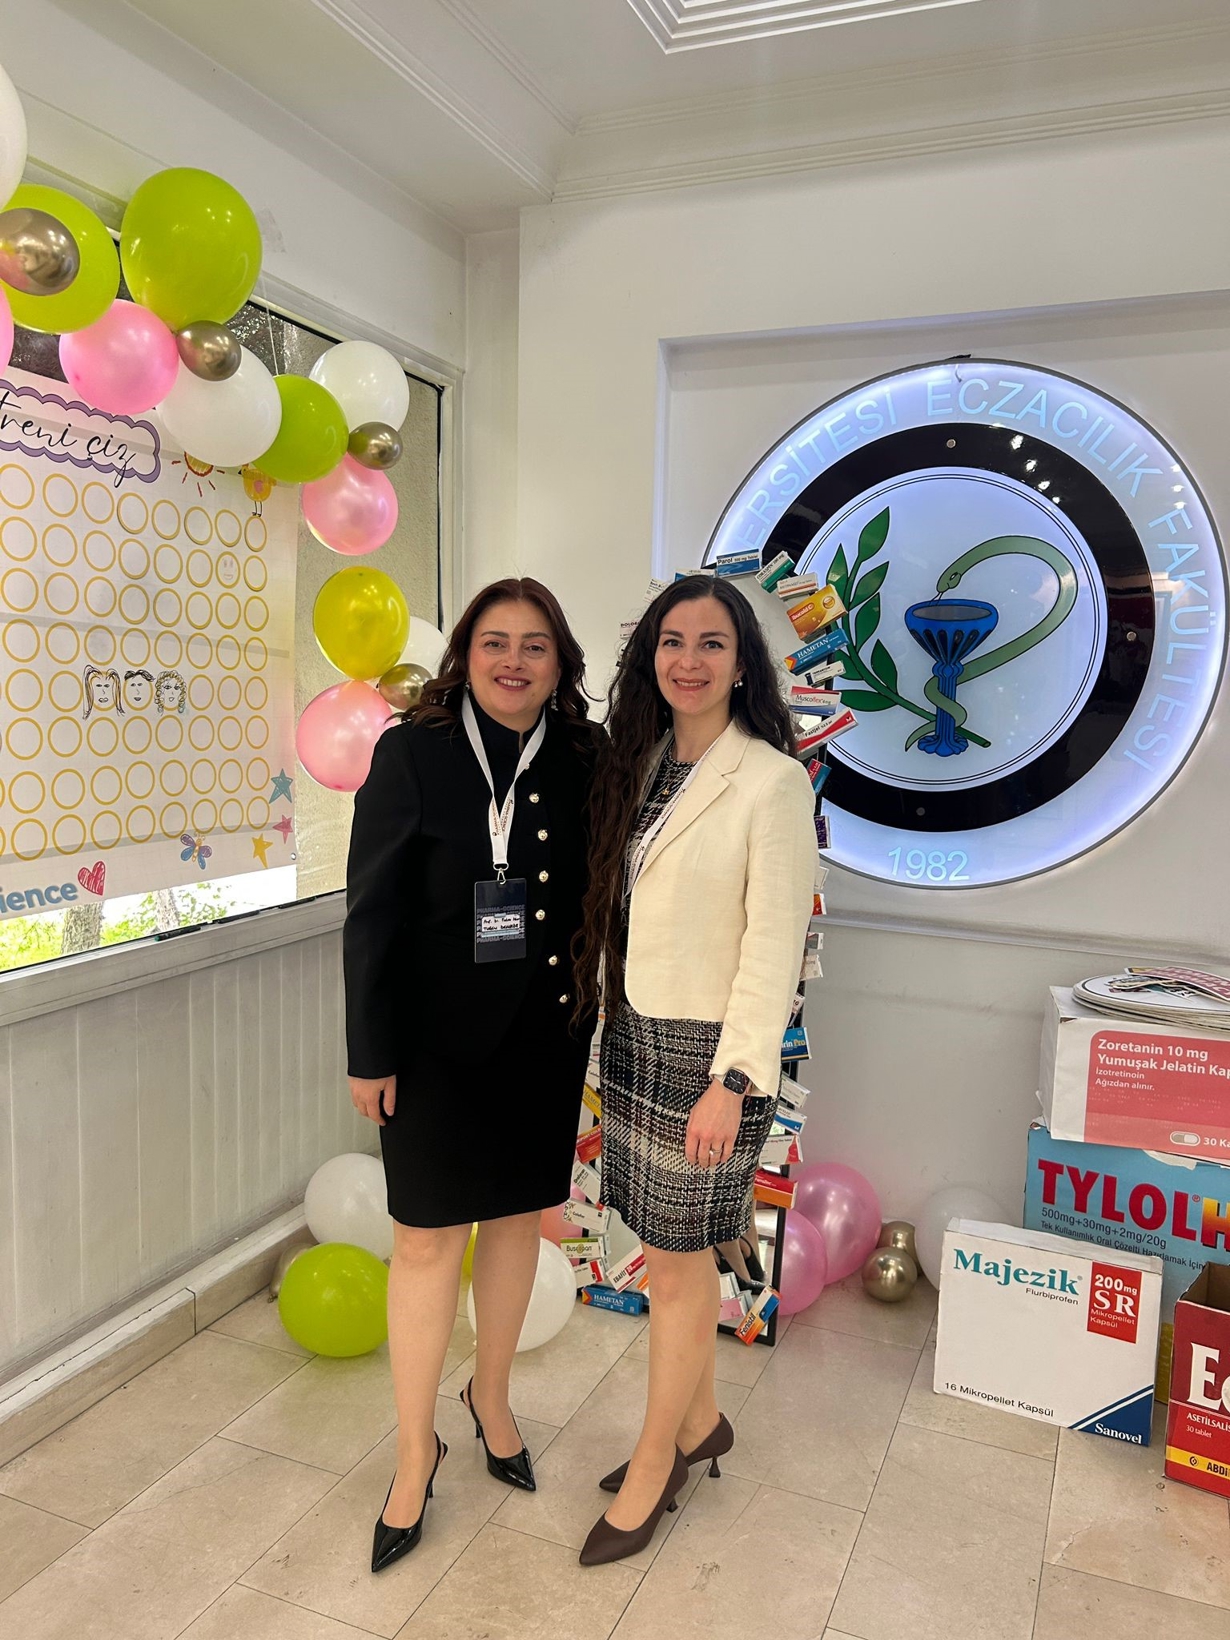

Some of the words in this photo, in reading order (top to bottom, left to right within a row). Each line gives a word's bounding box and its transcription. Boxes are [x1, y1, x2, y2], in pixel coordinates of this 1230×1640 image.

[926, 378, 1164, 498] ECZACILIK
[86, 434, 137, 488] çiz
[717, 557, 733, 565] Parol
[797, 639, 829, 658] HAMETAN
[888, 846, 970, 881] 1982
[0, 882, 78, 914] ience
[1097, 1038, 1163, 1055] Zoretanin
[1167, 1045, 1183, 1056] 10
[1186, 1049, 1208, 1062] mg
[1095, 1066, 1145, 1079] İzotretinoin
[1097, 1053, 1158, 1070] Yumuşak
[1160, 1060, 1205, 1075] Jelatin
[1095, 1078, 1130, 1088] Ağızdan
[1131, 1081, 1155, 1091] alınır.
[1203, 1137, 1217, 1146] 30
[1037, 1158, 1198, 1241] TYLOL
[1041, 1206, 1167, 1250] 500mg+30mg+2mg/20g
[1041, 1220, 1054, 1231] Tek
[1055, 1224, 1095, 1242] Kullanımlık
[1096, 1236, 1112, 1247] Oral
[1114, 1240, 1140, 1255] Çözelti
[953, 1248, 1080, 1296] Majezik
[1094, 1274, 1138, 1296] 200mg
[594, 1294, 624, 1306] HAMETAN
[1025, 1287, 1079, 1306] Flurbiprofen
[739, 1311, 757, 1337] Fenistil
[1090, 1309, 1136, 1326] Mikropellet
[1090, 1316, 1118, 1329] Kapsül
[945, 1382, 957, 1391] 16
[959, 1385, 1015, 1408] Mikropellet
[1017, 1401, 1054, 1418] Kapsül
[1094, 1422, 1142, 1445] Sanovel
[1186, 1425, 1194, 1433] 30
[1195, 1427, 1212, 1438] tablet
